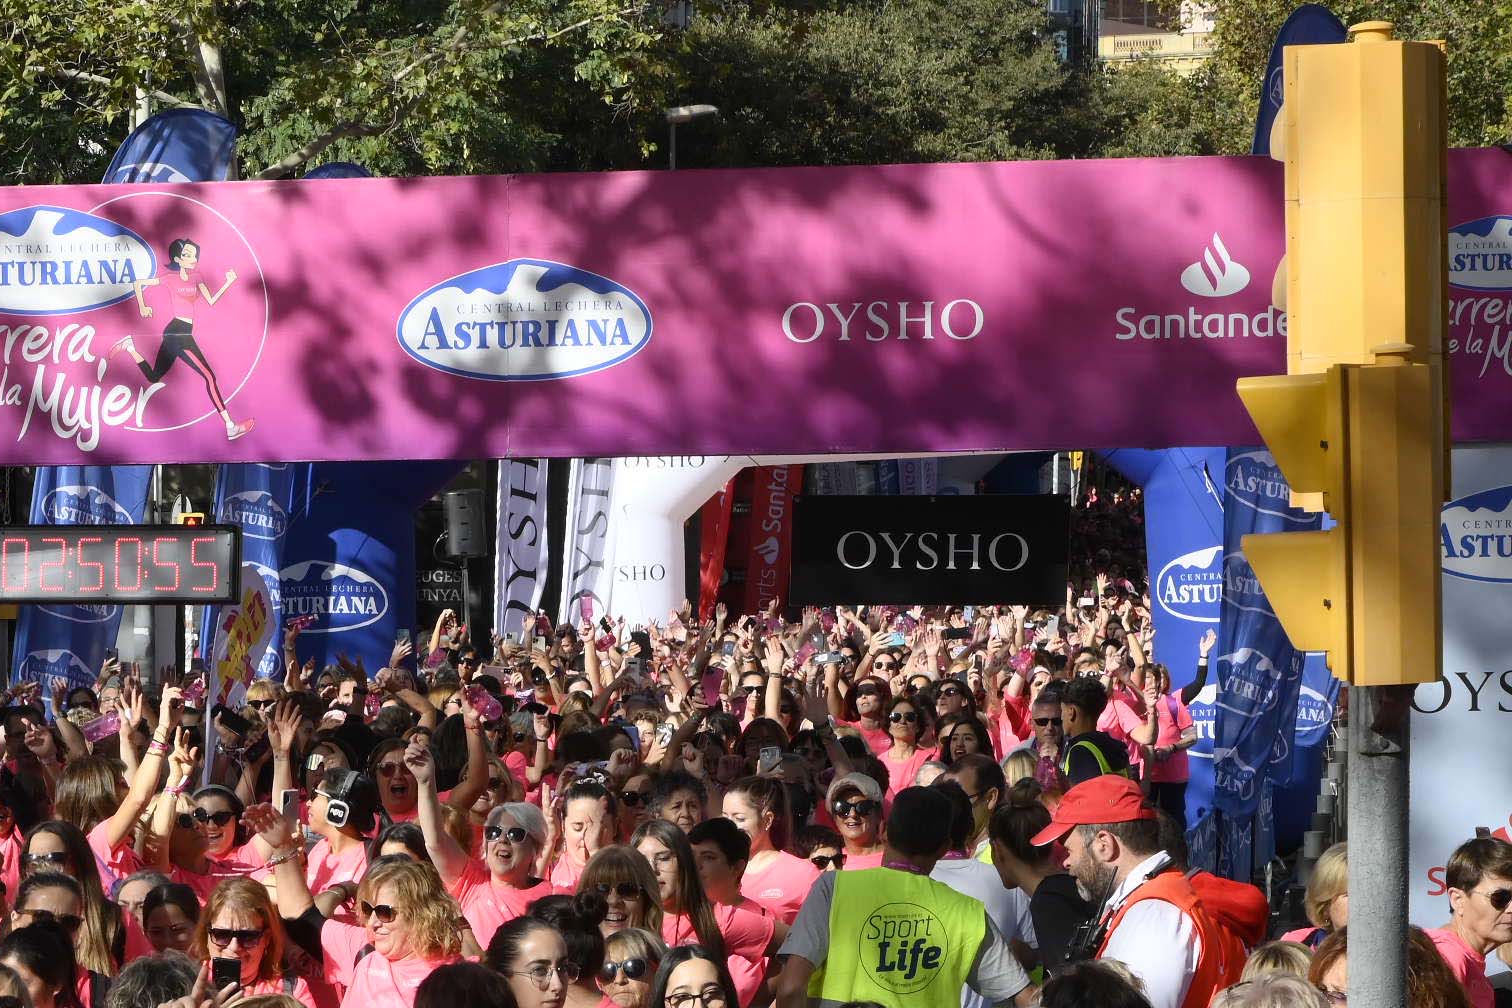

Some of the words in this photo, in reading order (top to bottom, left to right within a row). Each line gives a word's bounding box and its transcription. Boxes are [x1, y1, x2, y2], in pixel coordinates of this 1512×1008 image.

[417, 306, 633, 350] ASTURIANA
[457, 302, 535, 314] CENTRAL
[544, 300, 624, 312] LECHERA
[782, 299, 984, 344] OYSHO
[1116, 305, 1287, 341] Santande
[17, 357, 166, 450] Mujer
[2, 537, 218, 592] 02:50:55
[837, 531, 1029, 571] OYSHO
[867, 915, 934, 942] Sport
[876, 938, 942, 980] Life
